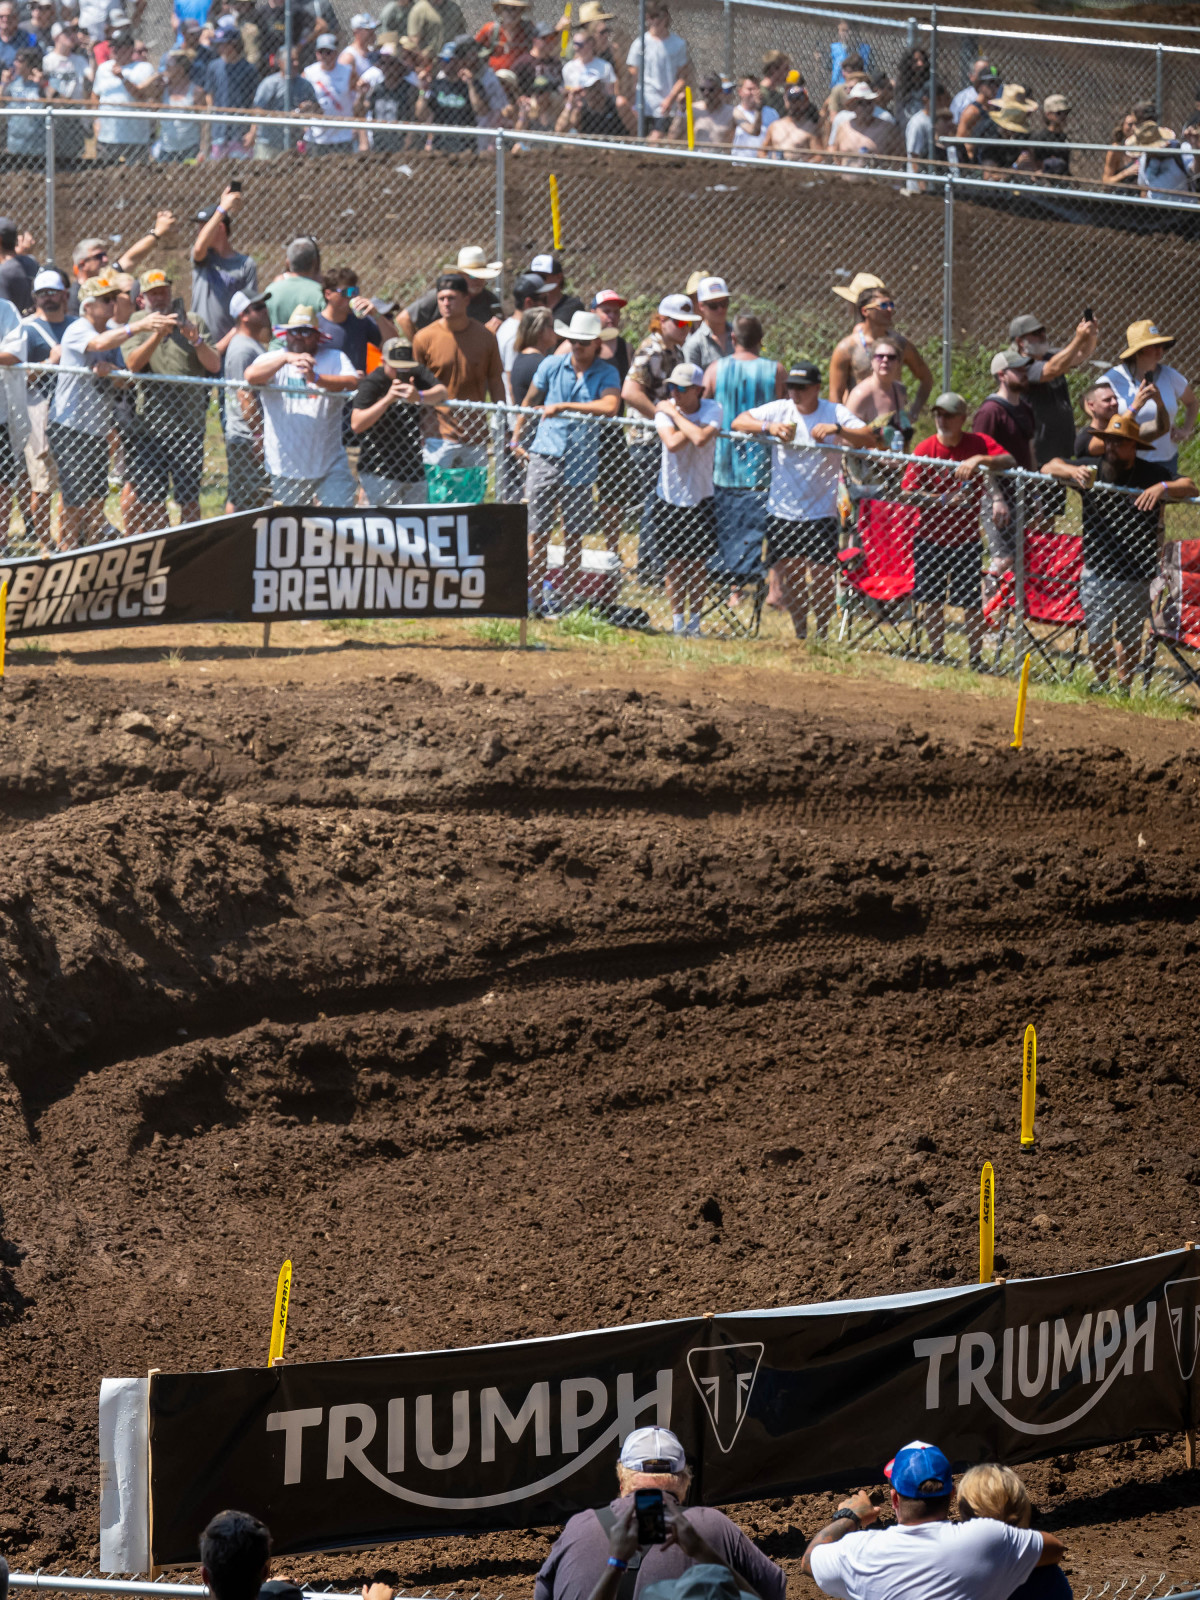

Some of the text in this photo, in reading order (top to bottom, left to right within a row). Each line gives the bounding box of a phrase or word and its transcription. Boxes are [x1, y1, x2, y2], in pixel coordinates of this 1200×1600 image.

[983, 1178, 991, 1224] ACERBIS
[279, 1278, 289, 1328] ACERBIS
[913, 1301, 1157, 1435] TRIUMPH
[266, 1368, 673, 1509] TRIUMPH
